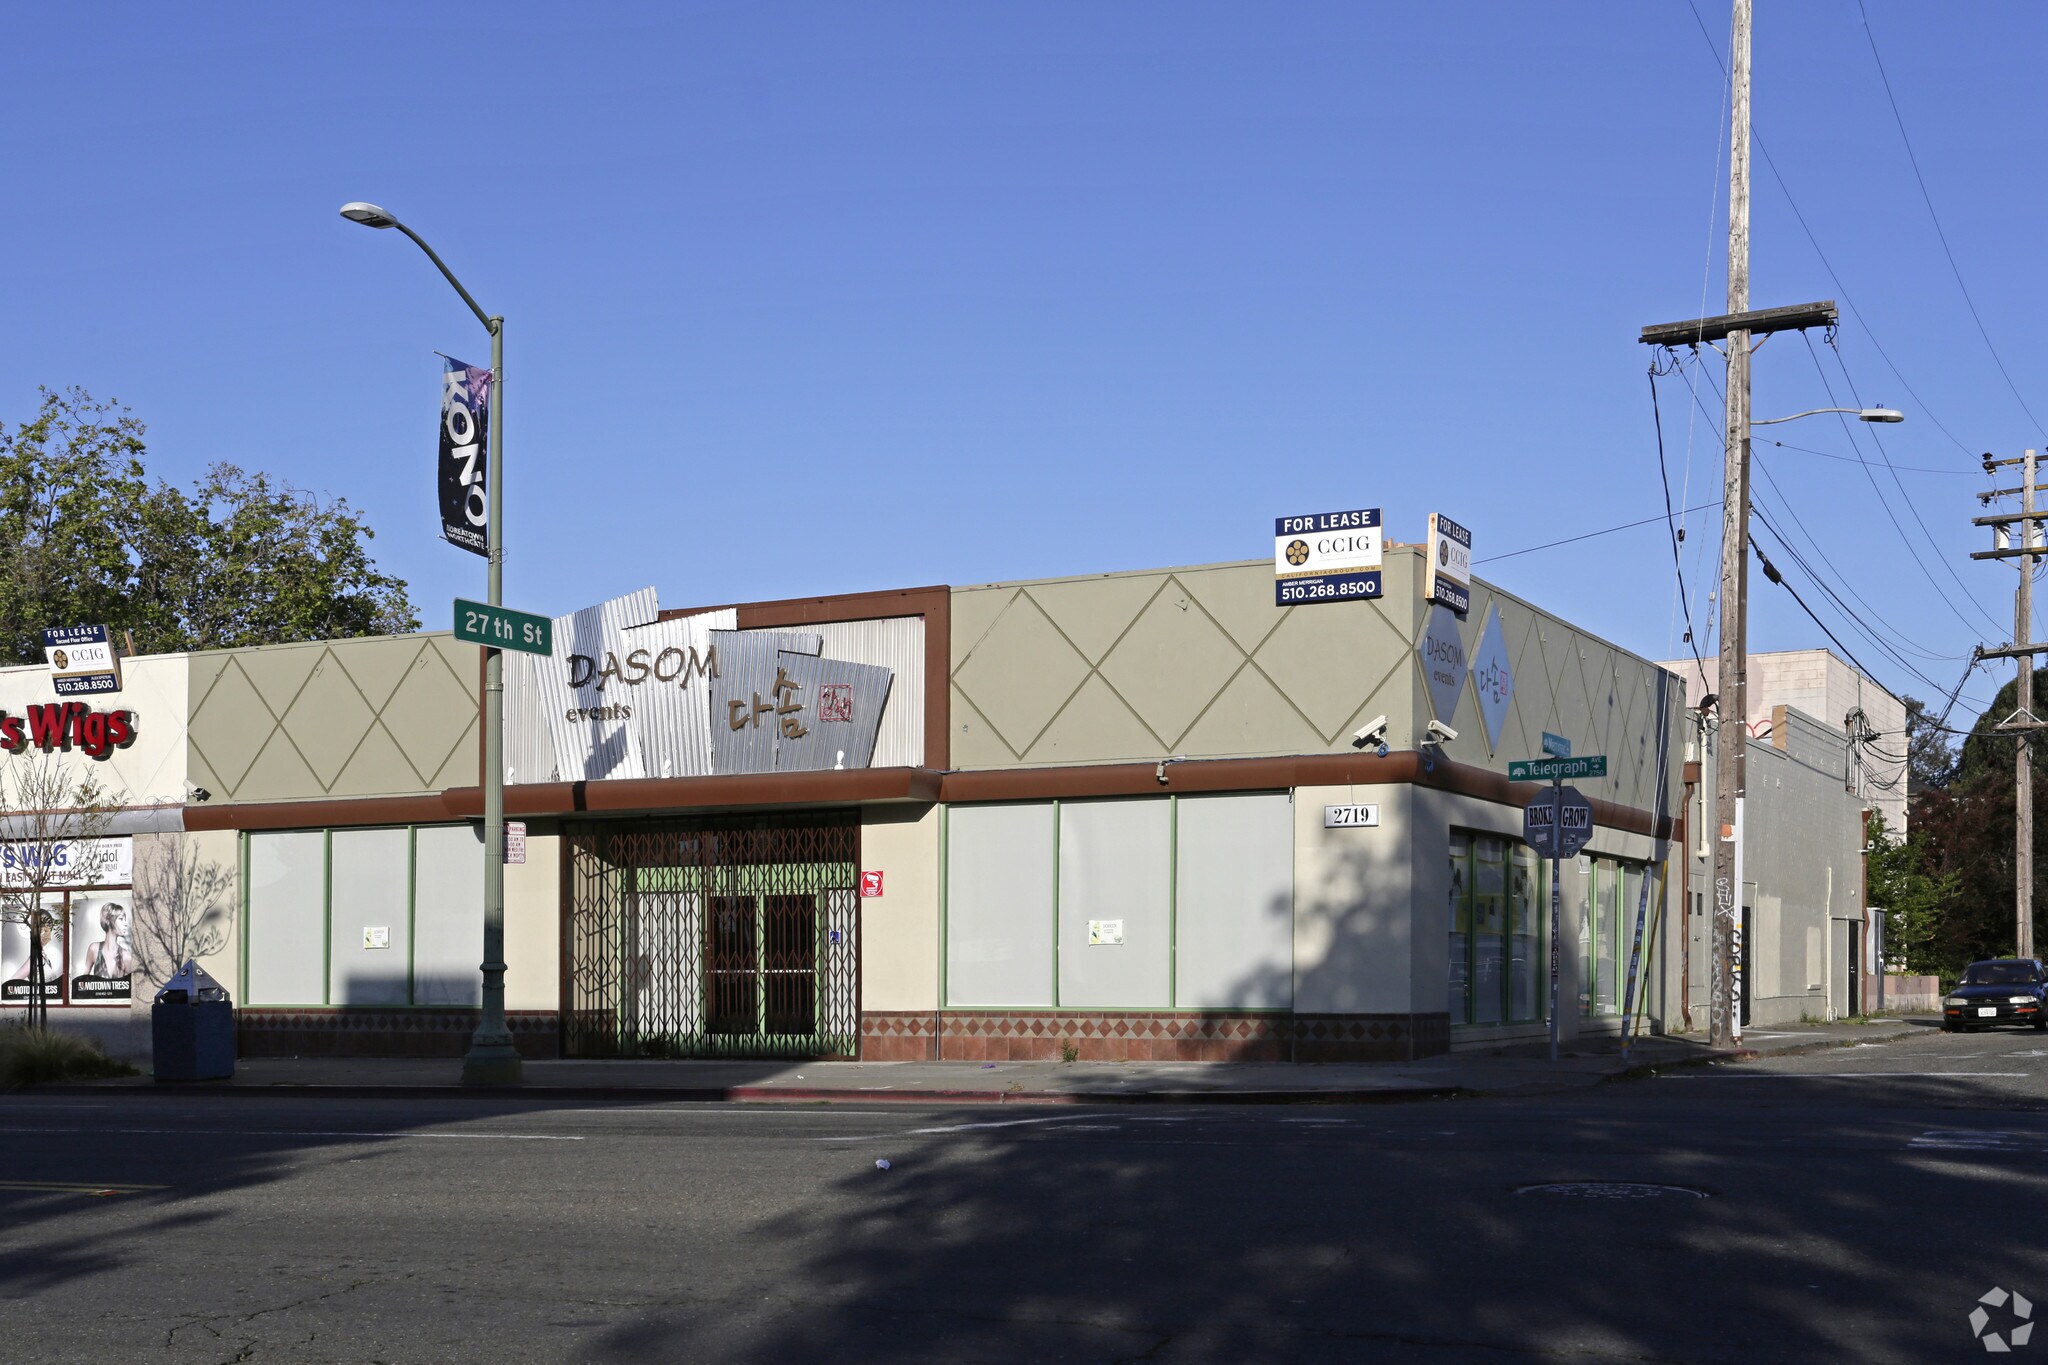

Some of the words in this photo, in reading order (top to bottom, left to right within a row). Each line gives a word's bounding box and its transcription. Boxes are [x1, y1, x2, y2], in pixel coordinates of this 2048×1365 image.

[442, 370, 487, 527] KONO
[1284, 517, 1314, 533] FOR
[1320, 511, 1371, 529] LEASE
[1440, 517, 1451, 534] FOR
[1452, 524, 1469, 544] LEASE
[1317, 535, 1370, 554] CCIG
[1451, 547, 1468, 568] CCIG
[1281, 566, 1376, 578] CALIFORNIAGROUP.COM
[1282, 581, 1375, 600] 510.268.8500
[1435, 585, 1468, 610] 510.268.8500
[47, 630, 65, 638] FOR
[68, 627, 99, 636] LEASE
[465, 611, 513, 640] 27th
[523, 622, 542, 645] St
[71, 648, 104, 661] CCIG
[1427, 636, 1462, 670] DASOM
[566, 645, 720, 692] DASOM
[1433, 670, 1455, 687] events
[57, 680, 113, 692] 510.268.8500
[1480, 656, 1500, 704] 다솜
[566, 702, 632, 723] events
[728, 668, 807, 739] 다솜
[26, 702, 128, 757] Wigs
[1527, 760, 1587, 778] Telegraph
[1334, 807, 1369, 824] 2719
[1529, 807, 1553, 827] BROKE
[1562, 807, 1588, 827] GROW
[0, 845, 15, 869] S
[99, 849, 119, 862] idol
[60, 870, 84, 881] MALL
[44, 985, 58, 995] RESS
[85, 981, 112, 991] MOTOWN
[112, 981, 130, 990] TRESS
